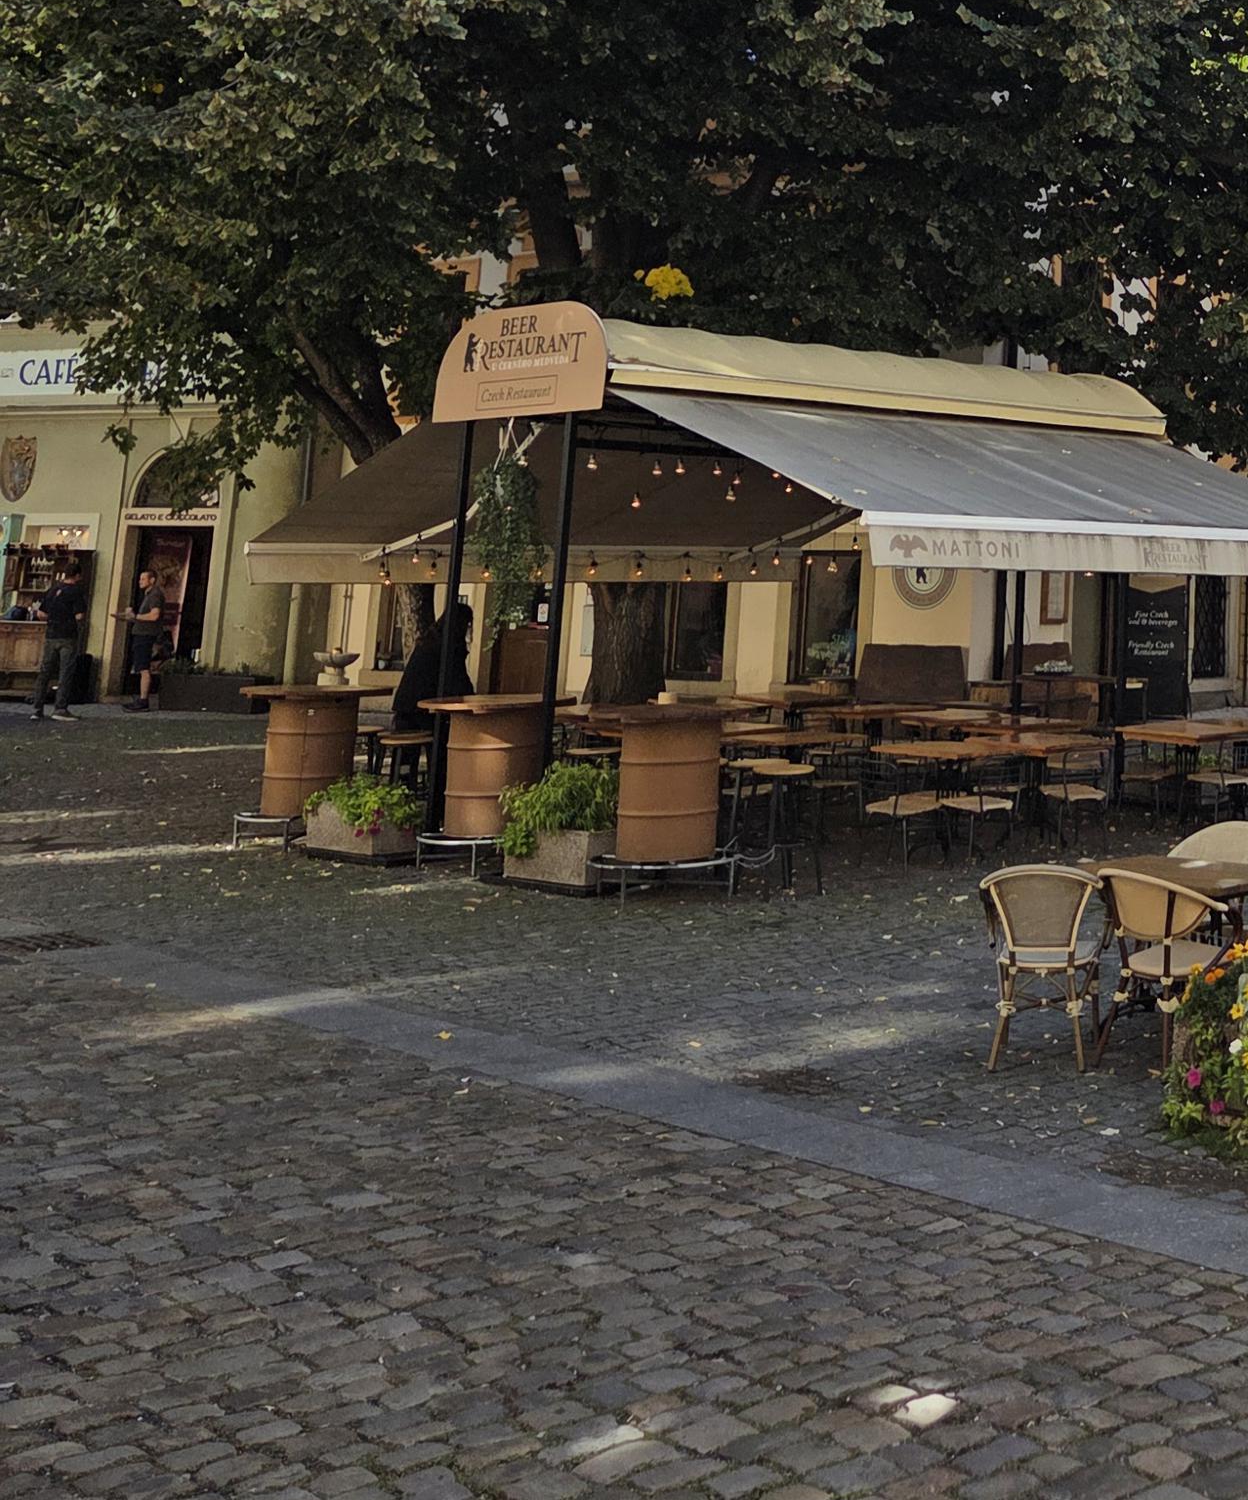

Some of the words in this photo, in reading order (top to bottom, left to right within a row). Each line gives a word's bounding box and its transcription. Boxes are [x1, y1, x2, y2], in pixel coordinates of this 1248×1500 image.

[500, 315, 538, 337] BEER
[480, 330, 587, 372] RESTAURANT
[481, 386, 504, 404] Czech
[506, 384, 551, 401] Restaurant
[124, 513, 156, 521] GELATO
[932, 539, 1020, 558] MATTONI
[1128, 640, 1154, 650] Friendly
